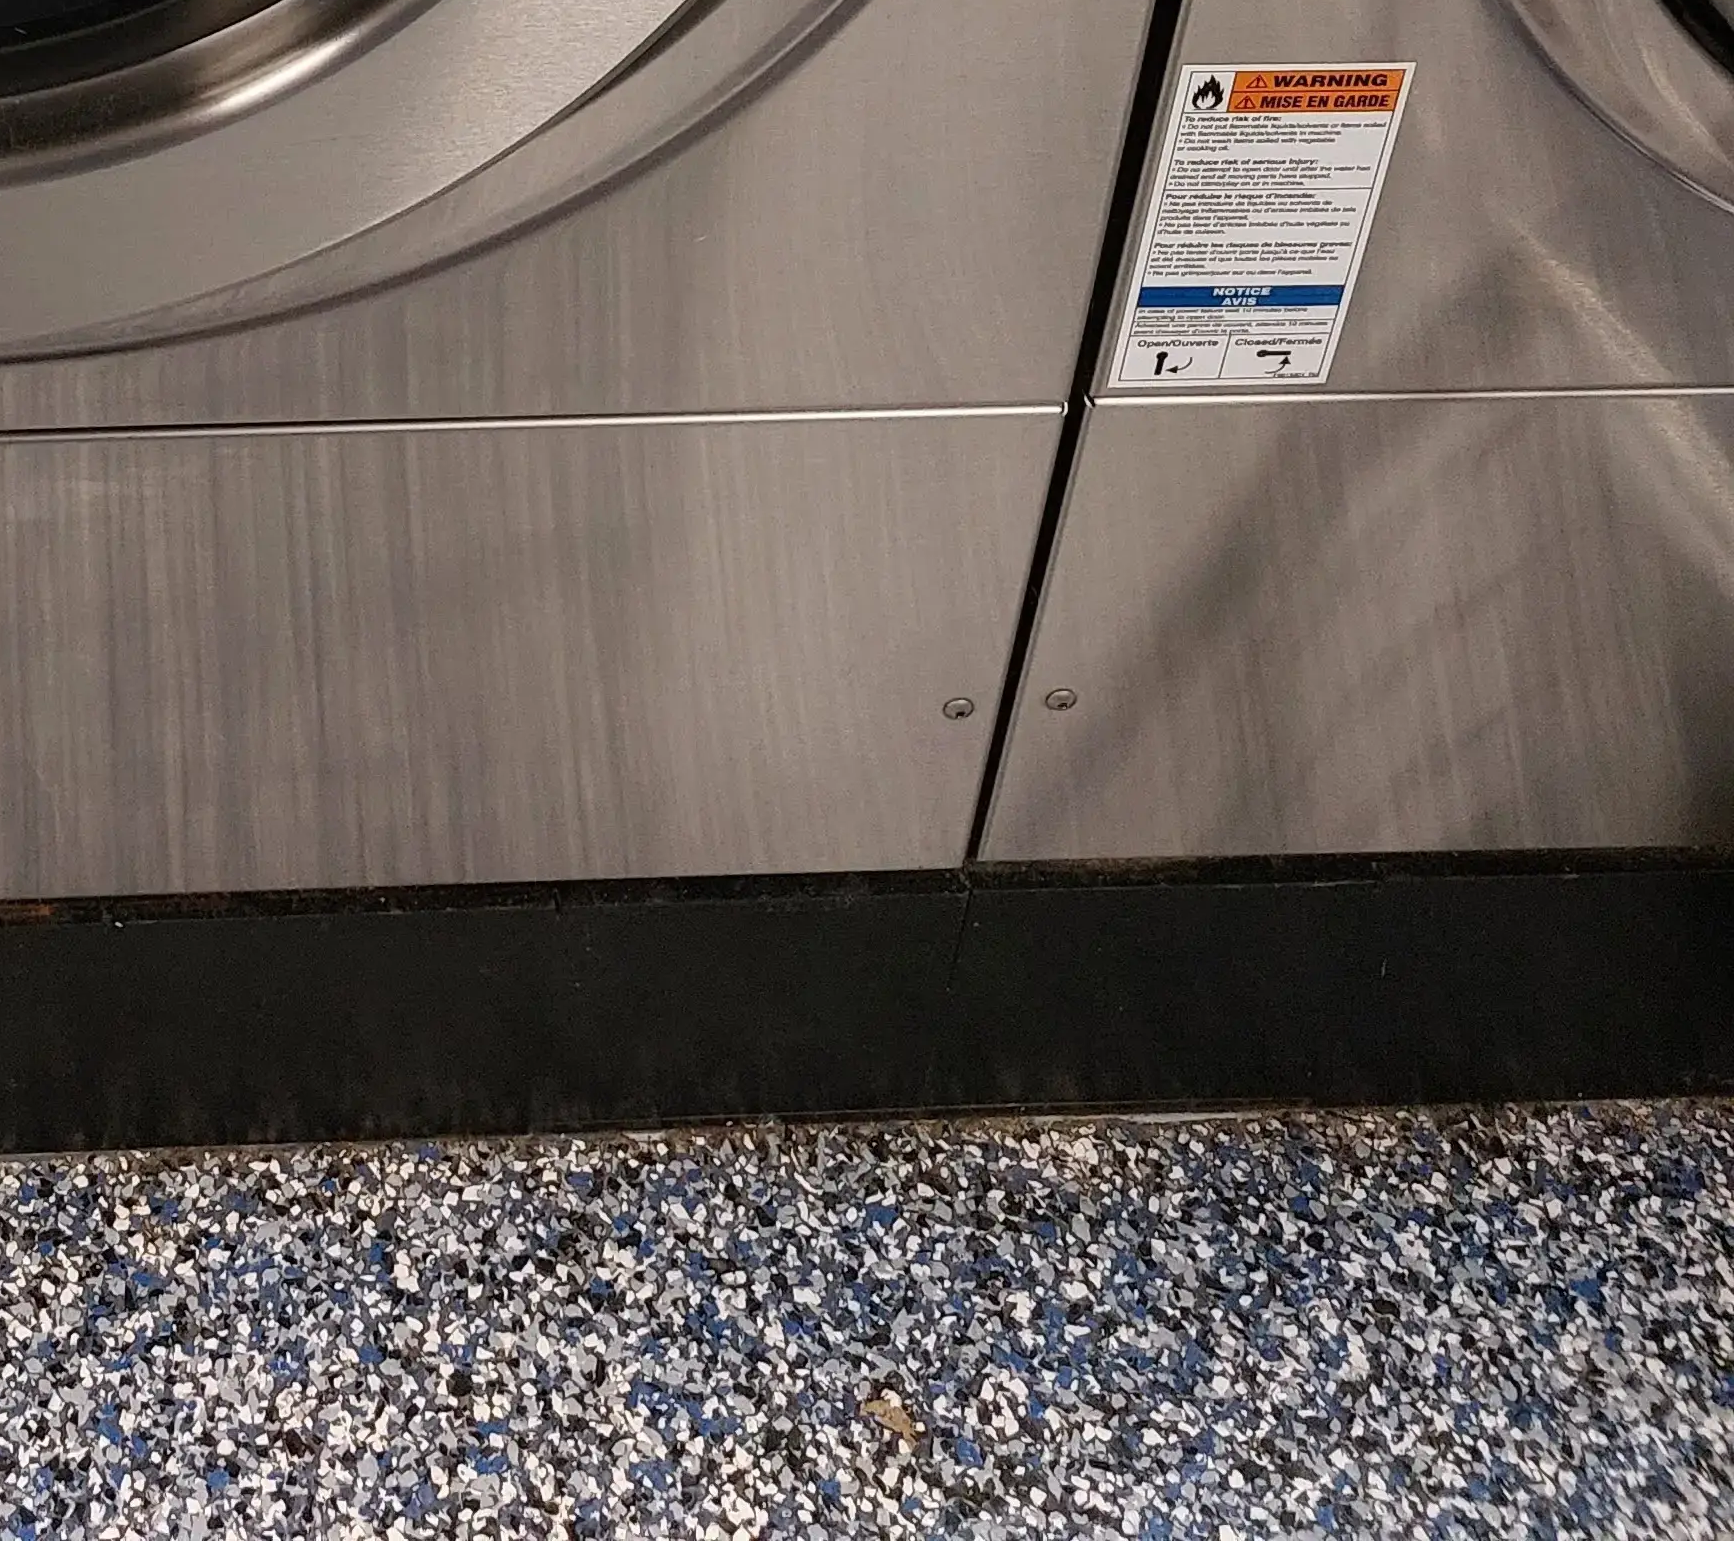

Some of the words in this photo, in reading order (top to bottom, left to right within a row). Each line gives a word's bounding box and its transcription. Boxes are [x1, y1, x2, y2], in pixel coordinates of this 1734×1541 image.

[1274, 74, 1388, 87] WARNING
[1260, 96, 1302, 108] MISE
[1306, 96, 1329, 108] EN
[1333, 95, 1390, 107] GARDE
[1213, 287, 1273, 296] NOTICE
[1221, 297, 1257, 305] AVIS
